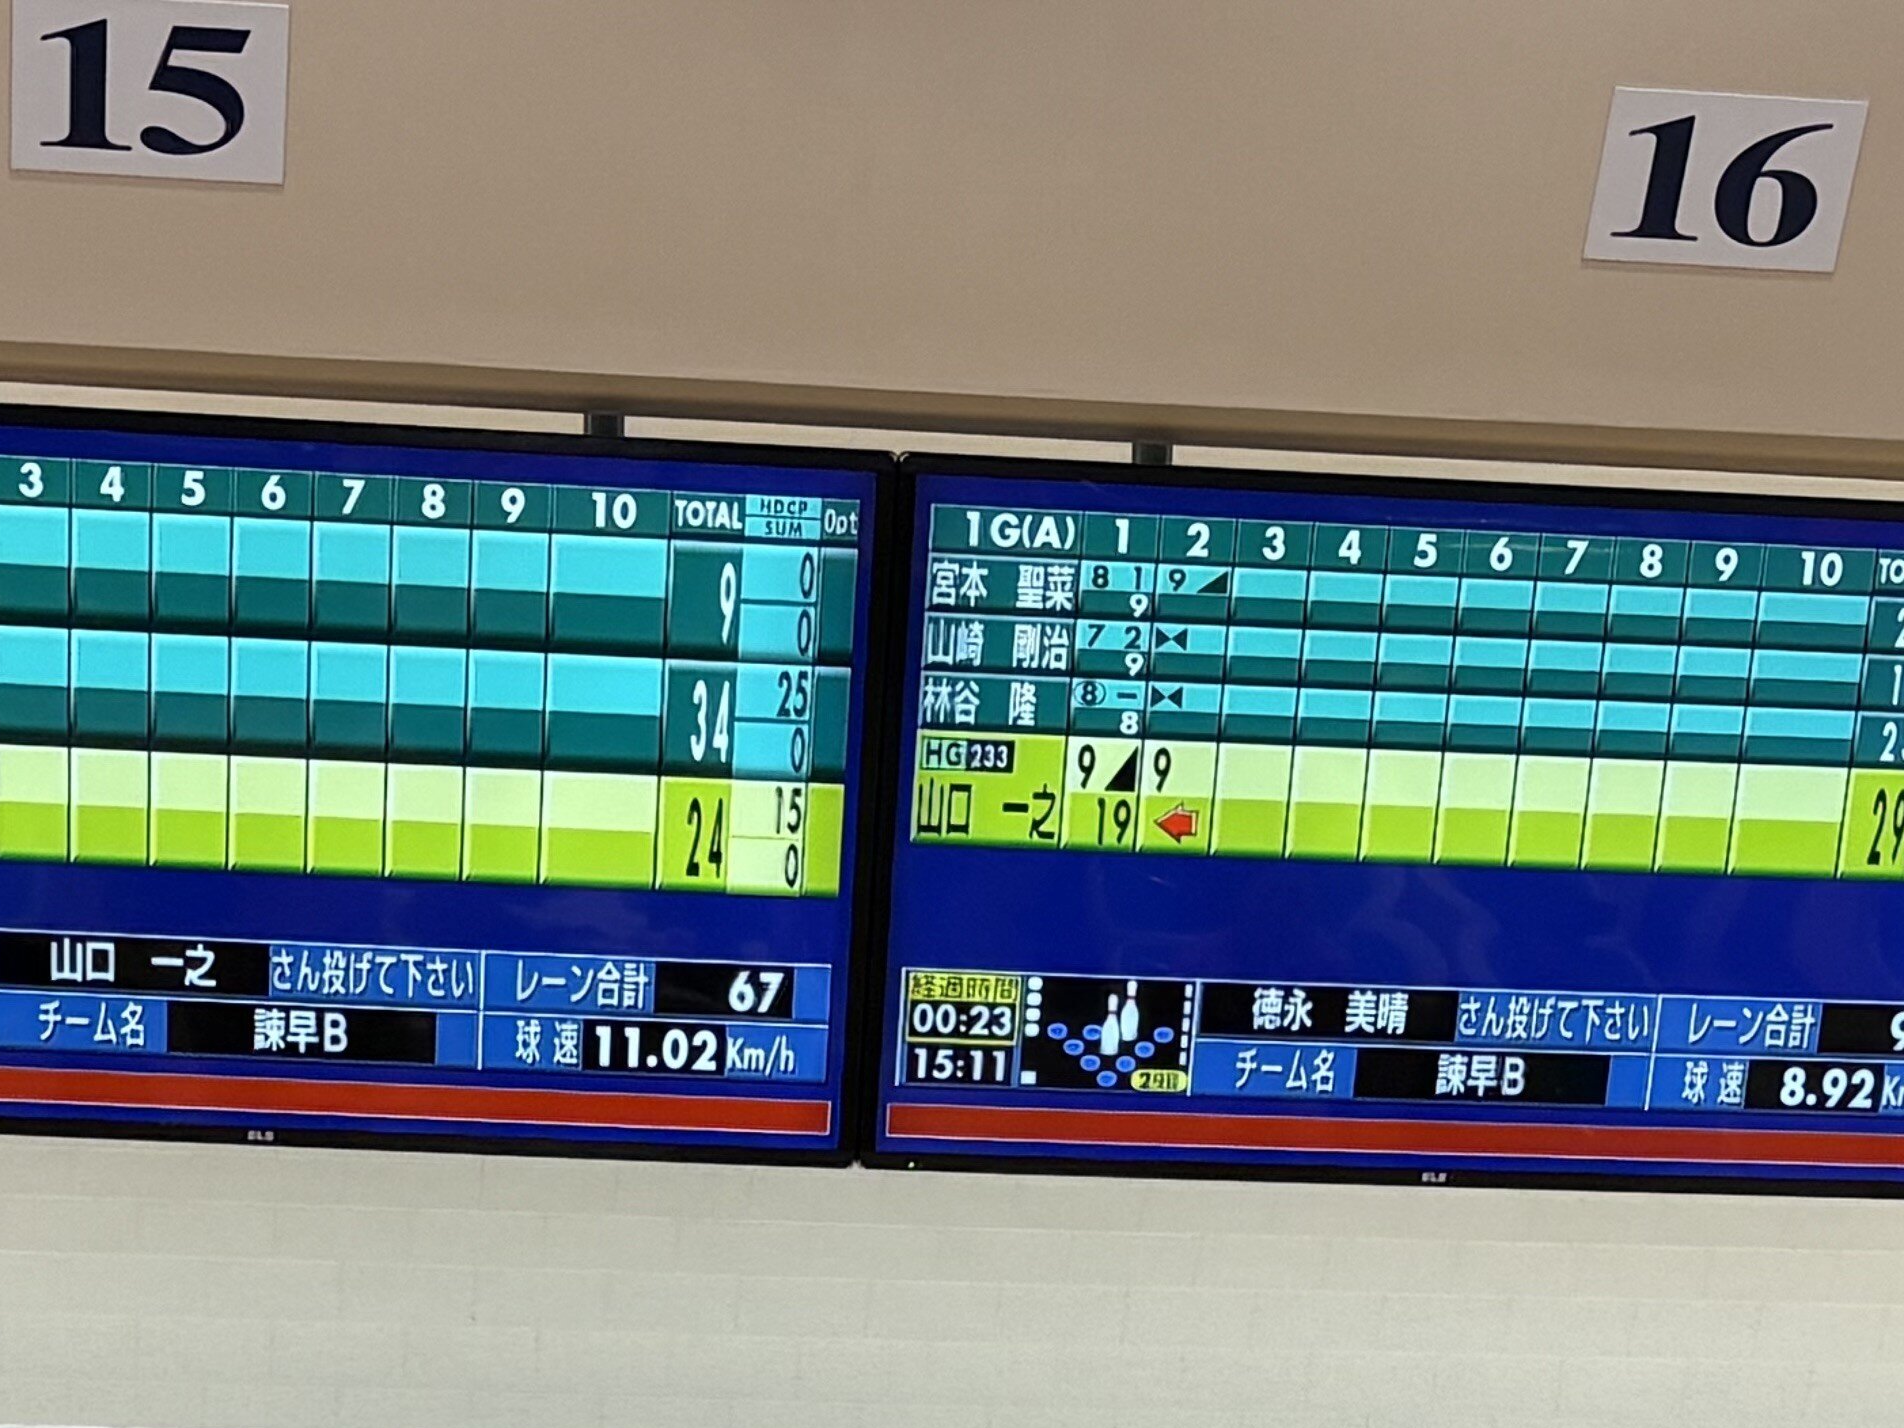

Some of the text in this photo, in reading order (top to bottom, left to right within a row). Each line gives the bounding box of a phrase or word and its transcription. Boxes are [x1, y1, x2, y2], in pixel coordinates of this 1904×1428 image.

[40, 18, 252, 155] 15
[1610, 115, 1834, 248] 16
[18, 463, 44, 498] 3
[99, 465, 124, 502] 4
[180, 470, 206, 506] 5
[261, 475, 286, 511] 6
[342, 478, 365, 515] 7
[422, 484, 446, 520] 8
[501, 487, 525, 524] 9
[592, 492, 637, 530] 10
[674, 499, 742, 530] TOTAL
[931, 559, 1075, 612] 宮本 聖菜
[1012, 623, 1069, 670] 剛治
[923, 677, 1036, 726] 林谷 隆
[918, 777, 1056, 840] 山口 一之
[50, 941, 785, 1014] 山口 一之 さん投げて下さい レーン合計 67
[38, 1003, 146, 1048] チーム名
[253, 1008, 349, 1054] 諫早B
[596, 1026, 719, 1072] 11.02
[726, 1034, 795, 1074] Km/h
[912, 1003, 1013, 1037] 00:23
[1252, 987, 1312, 1031] 徳永
[1345, 990, 1409, 1035] 美晴
[1459, 996, 1649, 1041] さん投げて下さい
[1688, 1003, 1815, 1049] レーン合計
[914, 1047, 1007, 1083] 15:11
[1235, 1049, 1335, 1092] チーム名
[1435, 1053, 1525, 1097] 諫早B
[1780, 1067, 1875, 1110] 8.92
